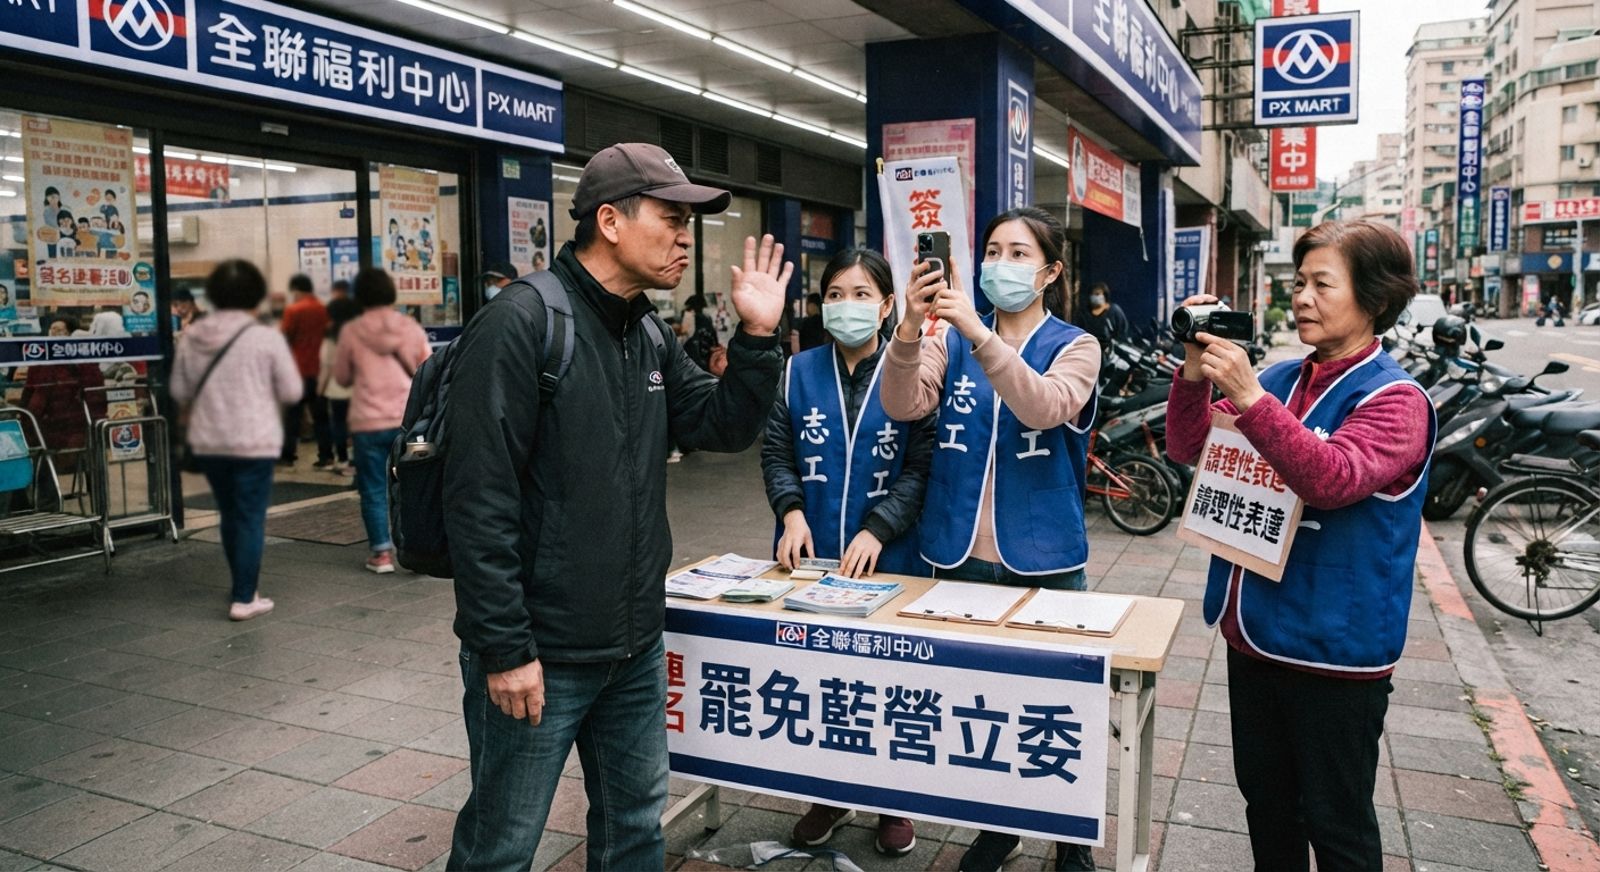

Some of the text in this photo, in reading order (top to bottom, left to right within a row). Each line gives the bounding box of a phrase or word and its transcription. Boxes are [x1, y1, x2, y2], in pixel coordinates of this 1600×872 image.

[207, 12, 470, 114] 全聯福利中心
[487, 91, 557, 124] PX MART
[1269, 98, 1342, 115] PX MART
[800, 406, 830, 483] 志工
[939, 374, 977, 453] 志工
[1015, 430, 1051, 460] 工
[866, 421, 899, 498] 志工
[699, 661, 1082, 784] 罷免藍營立委
